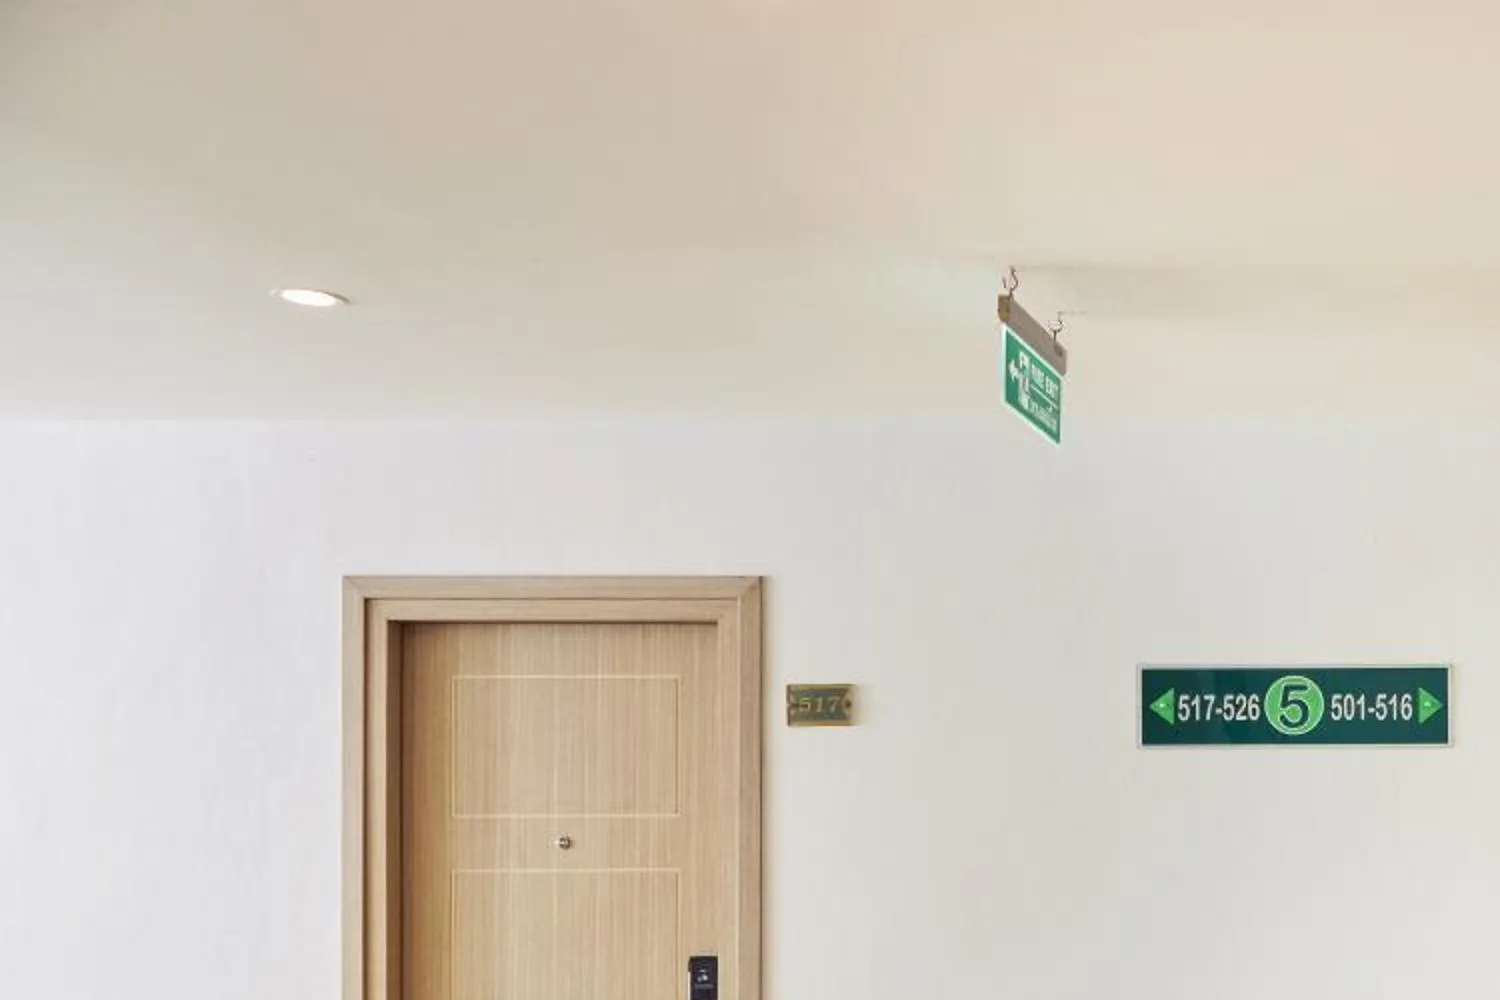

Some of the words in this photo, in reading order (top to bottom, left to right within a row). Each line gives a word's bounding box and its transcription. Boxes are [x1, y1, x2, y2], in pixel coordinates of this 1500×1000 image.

[799, 696, 841, 713] 517
[1178, 694, 1260, 721] 517-526
[1279, 682, 1311, 730] 5
[1331, 693, 1413, 721] 501-516
